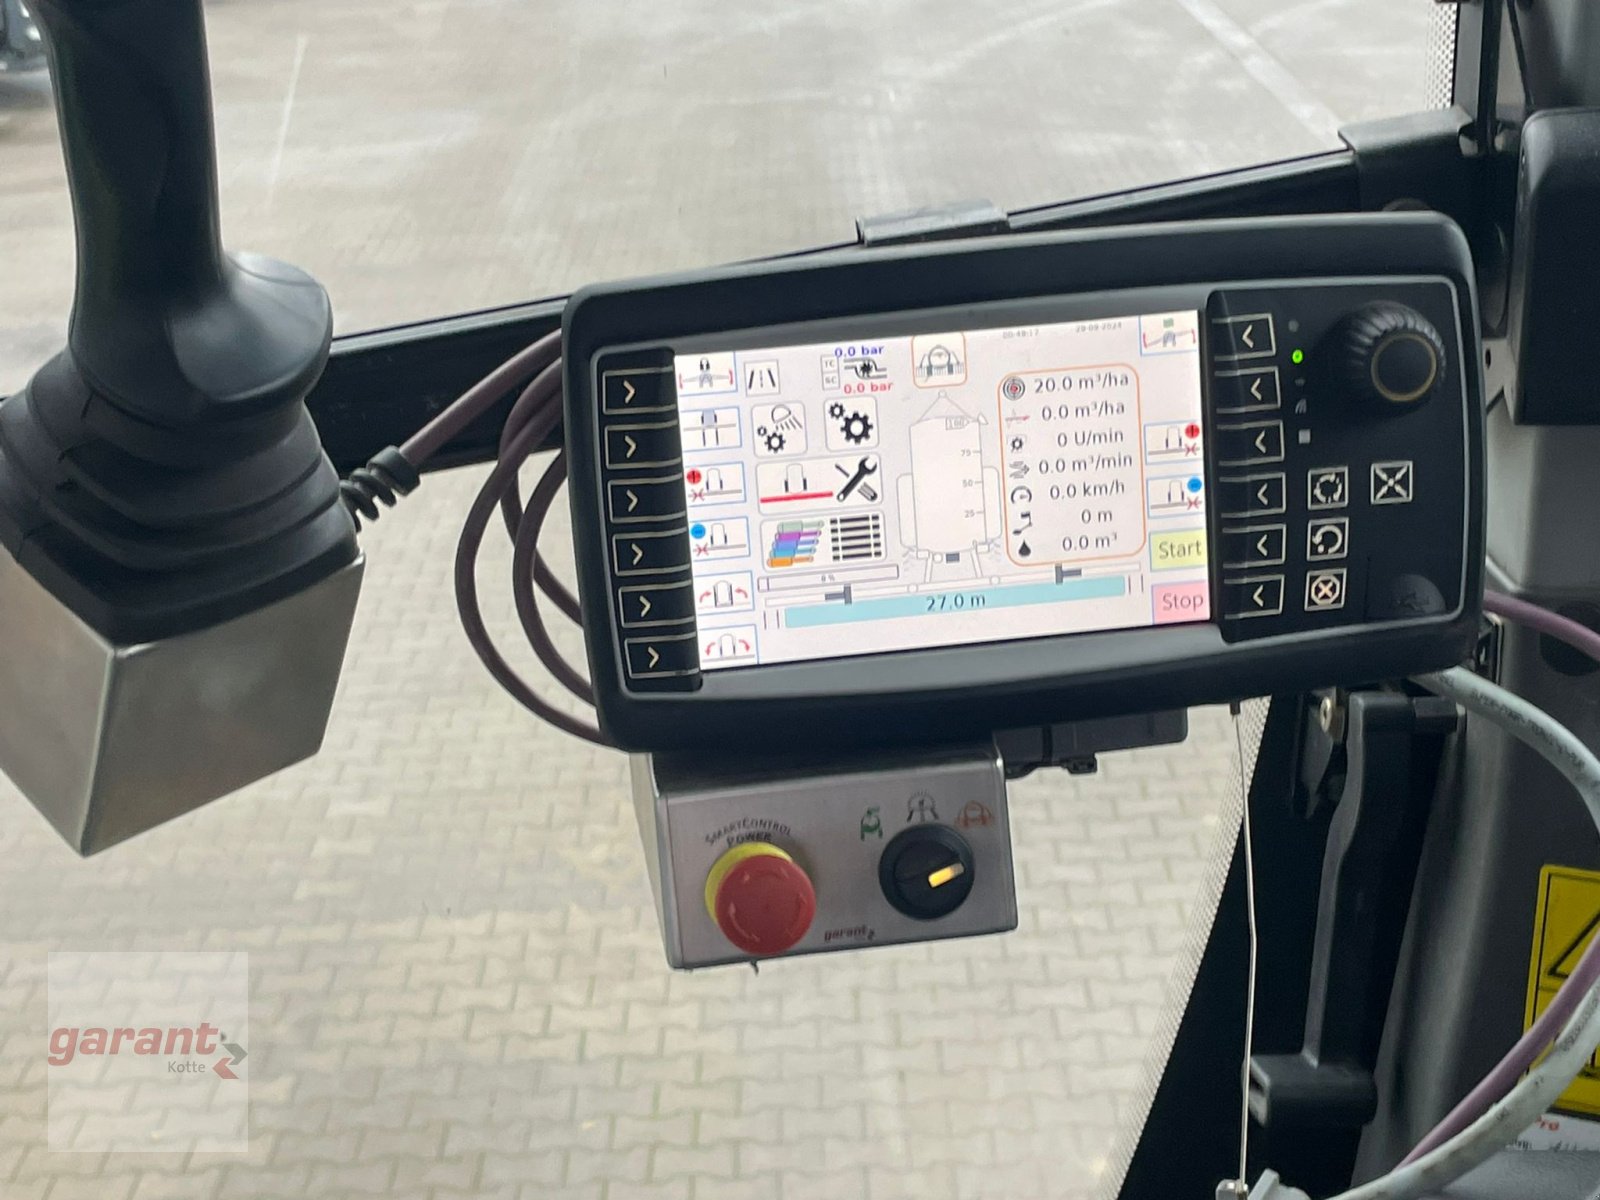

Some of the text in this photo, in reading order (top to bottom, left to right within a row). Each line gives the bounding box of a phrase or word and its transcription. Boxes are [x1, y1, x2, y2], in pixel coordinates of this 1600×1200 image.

[834, 345, 884, 358] 0.0 bar
[844, 382, 894, 394] 0.0 bar
[1034, 376, 1073, 394] 20.0
[1041, 405, 1070, 422] 0.0
[1057, 430, 1124, 448] 0 U/min
[960, 448, 972, 457] 75
[1038, 458, 1065, 475] 0.0
[962, 479, 973, 488] 50
[1050, 481, 1125, 500] 0.0 km/h
[964, 510, 974, 518] 25
[1081, 509, 1113, 524] 0 m
[1062, 535, 1089, 552] 0.0
[1158, 540, 1202, 559] Start
[926, 594, 986, 610] 27.0 m
[1162, 593, 1204, 613] Stop
[824, 924, 867, 942] garant
